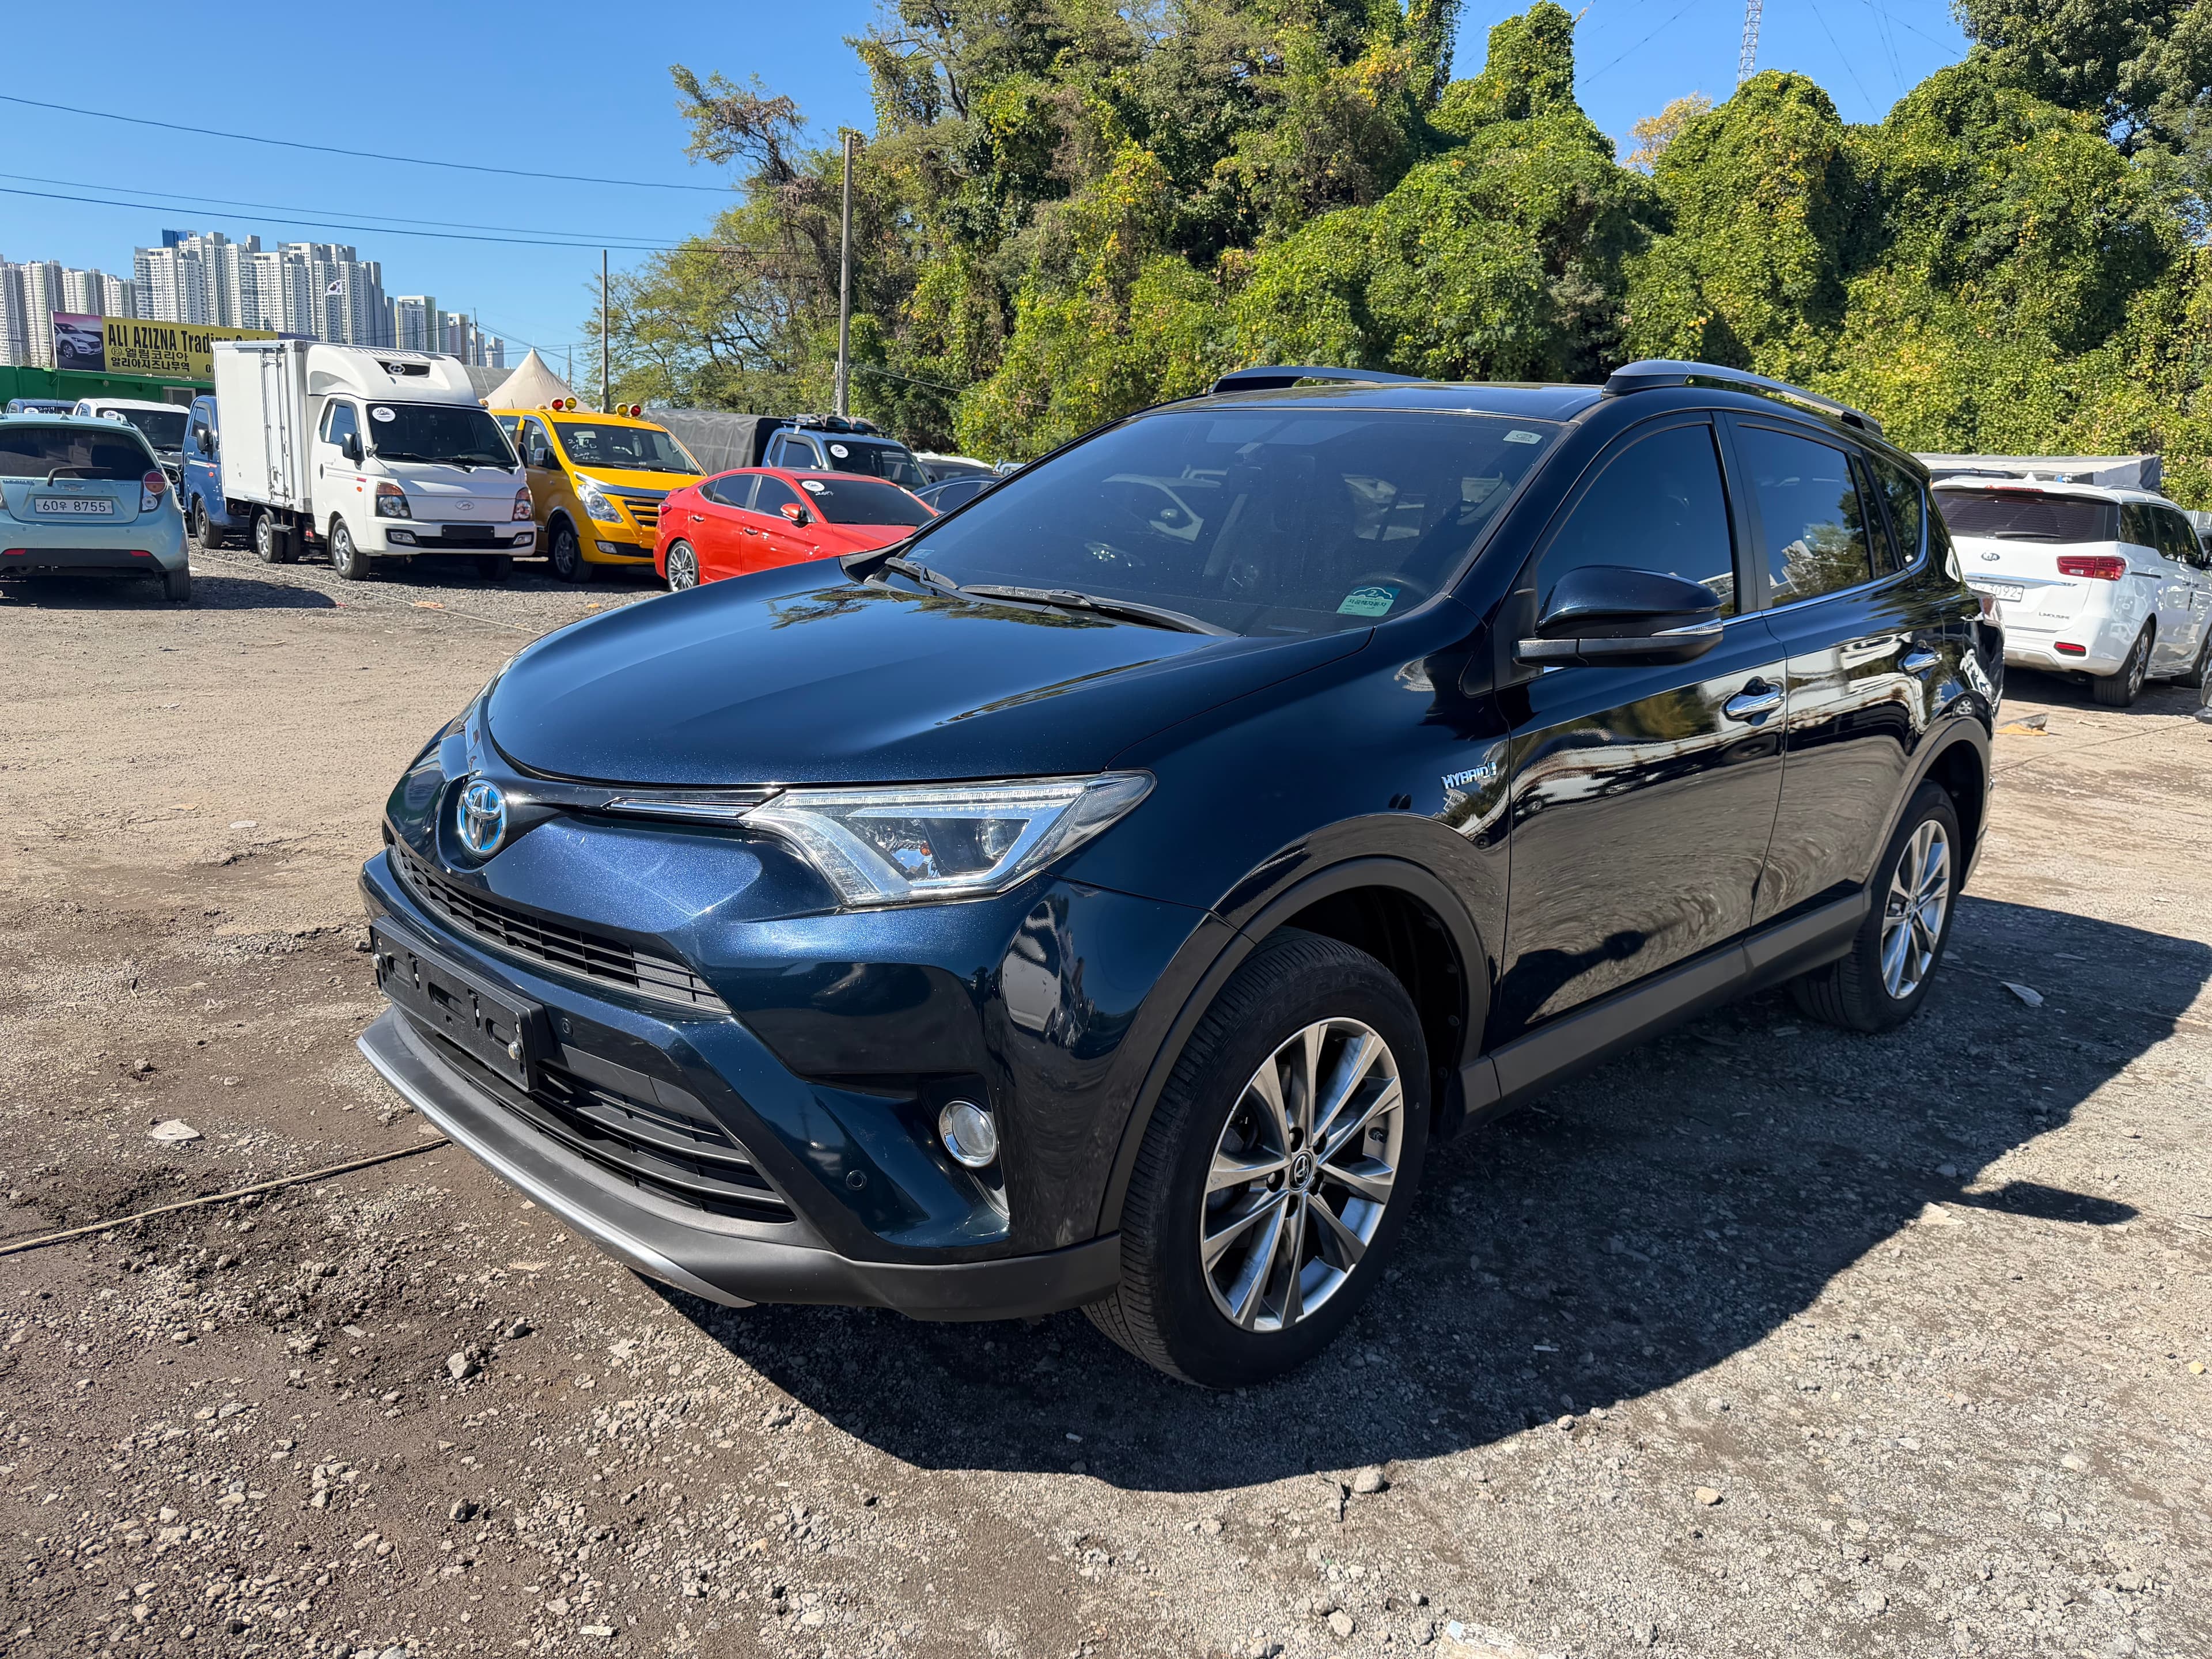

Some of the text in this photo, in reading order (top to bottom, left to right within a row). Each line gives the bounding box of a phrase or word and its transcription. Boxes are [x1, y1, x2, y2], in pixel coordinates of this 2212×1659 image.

[108, 324, 230, 354] ALI AZIZNA Tradi
[125, 347, 188, 361] 엘림코리아
[43, 501, 106, 512] 60우 8755
[1441, 766, 1490, 790] HYBRID
